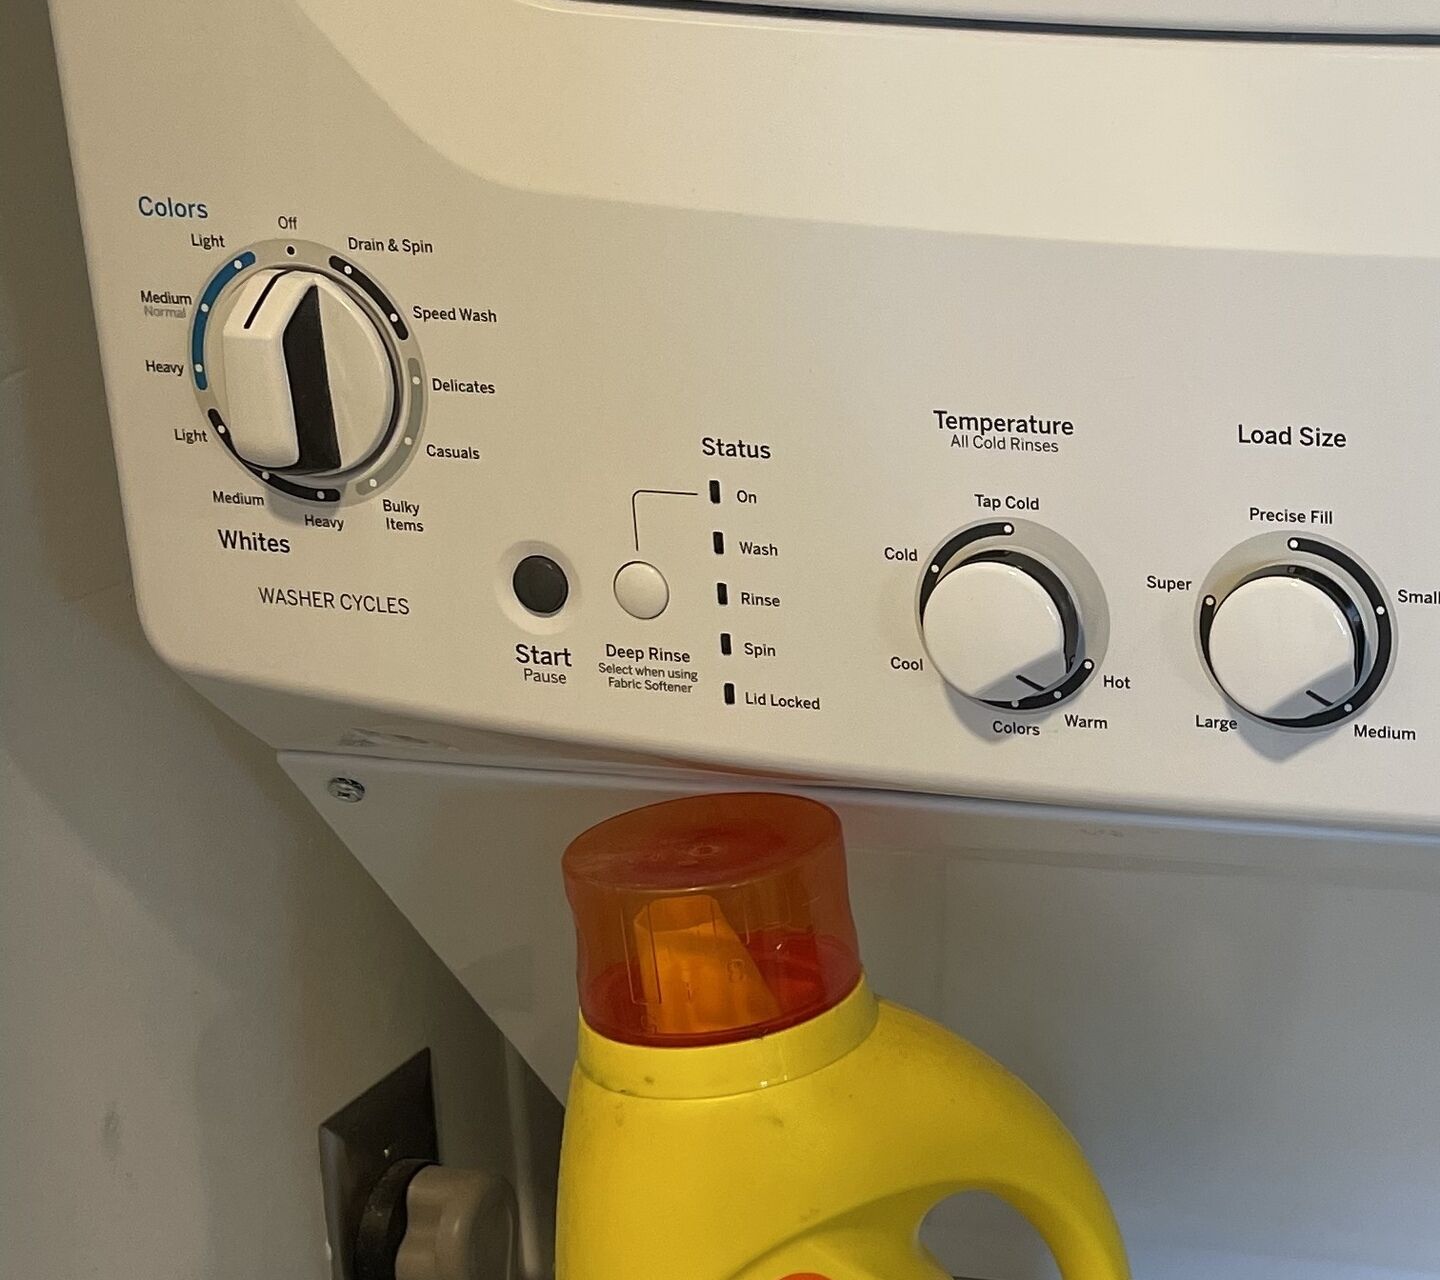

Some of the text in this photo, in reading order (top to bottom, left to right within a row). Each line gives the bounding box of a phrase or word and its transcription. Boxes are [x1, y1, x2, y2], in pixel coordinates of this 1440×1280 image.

[138, 196, 208, 218] Colors
[278, 216, 297, 230] Off
[191, 234, 225, 250] Light
[348, 237, 433, 255] Drain & Spin
[140, 290, 192, 305] Medium
[144, 305, 186, 319] Normal
[413, 306, 497, 324] Speed Wash
[145, 360, 184, 377] Heavy
[432, 378, 496, 394] Delicates
[933, 410, 1074, 436] Temperature
[174, 428, 208, 444] Light
[950, 434, 1059, 453] All Cold Rinses
[1237, 424, 1347, 448] Load Size
[426, 444, 480, 460] Casuals
[702, 437, 771, 459] Status
[212, 490, 265, 506] Medium
[736, 490, 757, 504] On
[974, 494, 1040, 511] Tap Cold
[382, 499, 420, 516] Bulky
[1249, 507, 1333, 524] Precise Fill
[304, 514, 345, 531] Heavy
[386, 518, 424, 533] Items
[217, 529, 291, 553] Whites
[739, 541, 778, 557] Wash
[884, 547, 918, 562] Cold
[1146, 575, 1192, 592] Super
[258, 586, 410, 615] WASHER CYCLES
[741, 592, 781, 607] Rinse
[515, 644, 572, 667] Start
[605, 644, 690, 663] Deep Rinse
[744, 643, 776, 657] Spin
[890, 657, 923, 671] Cool
[523, 669, 567, 684] Pause
[598, 662, 698, 683] Select when using
[608, 677, 693, 693] Fabric Softener
[1103, 675, 1131, 689] Hot
[745, 693, 820, 710] Lid Locked
[992, 721, 1040, 736] Colors
[1064, 714, 1108, 729] Warm
[1195, 715, 1238, 732] Large
[1354, 724, 1416, 740] Medium
